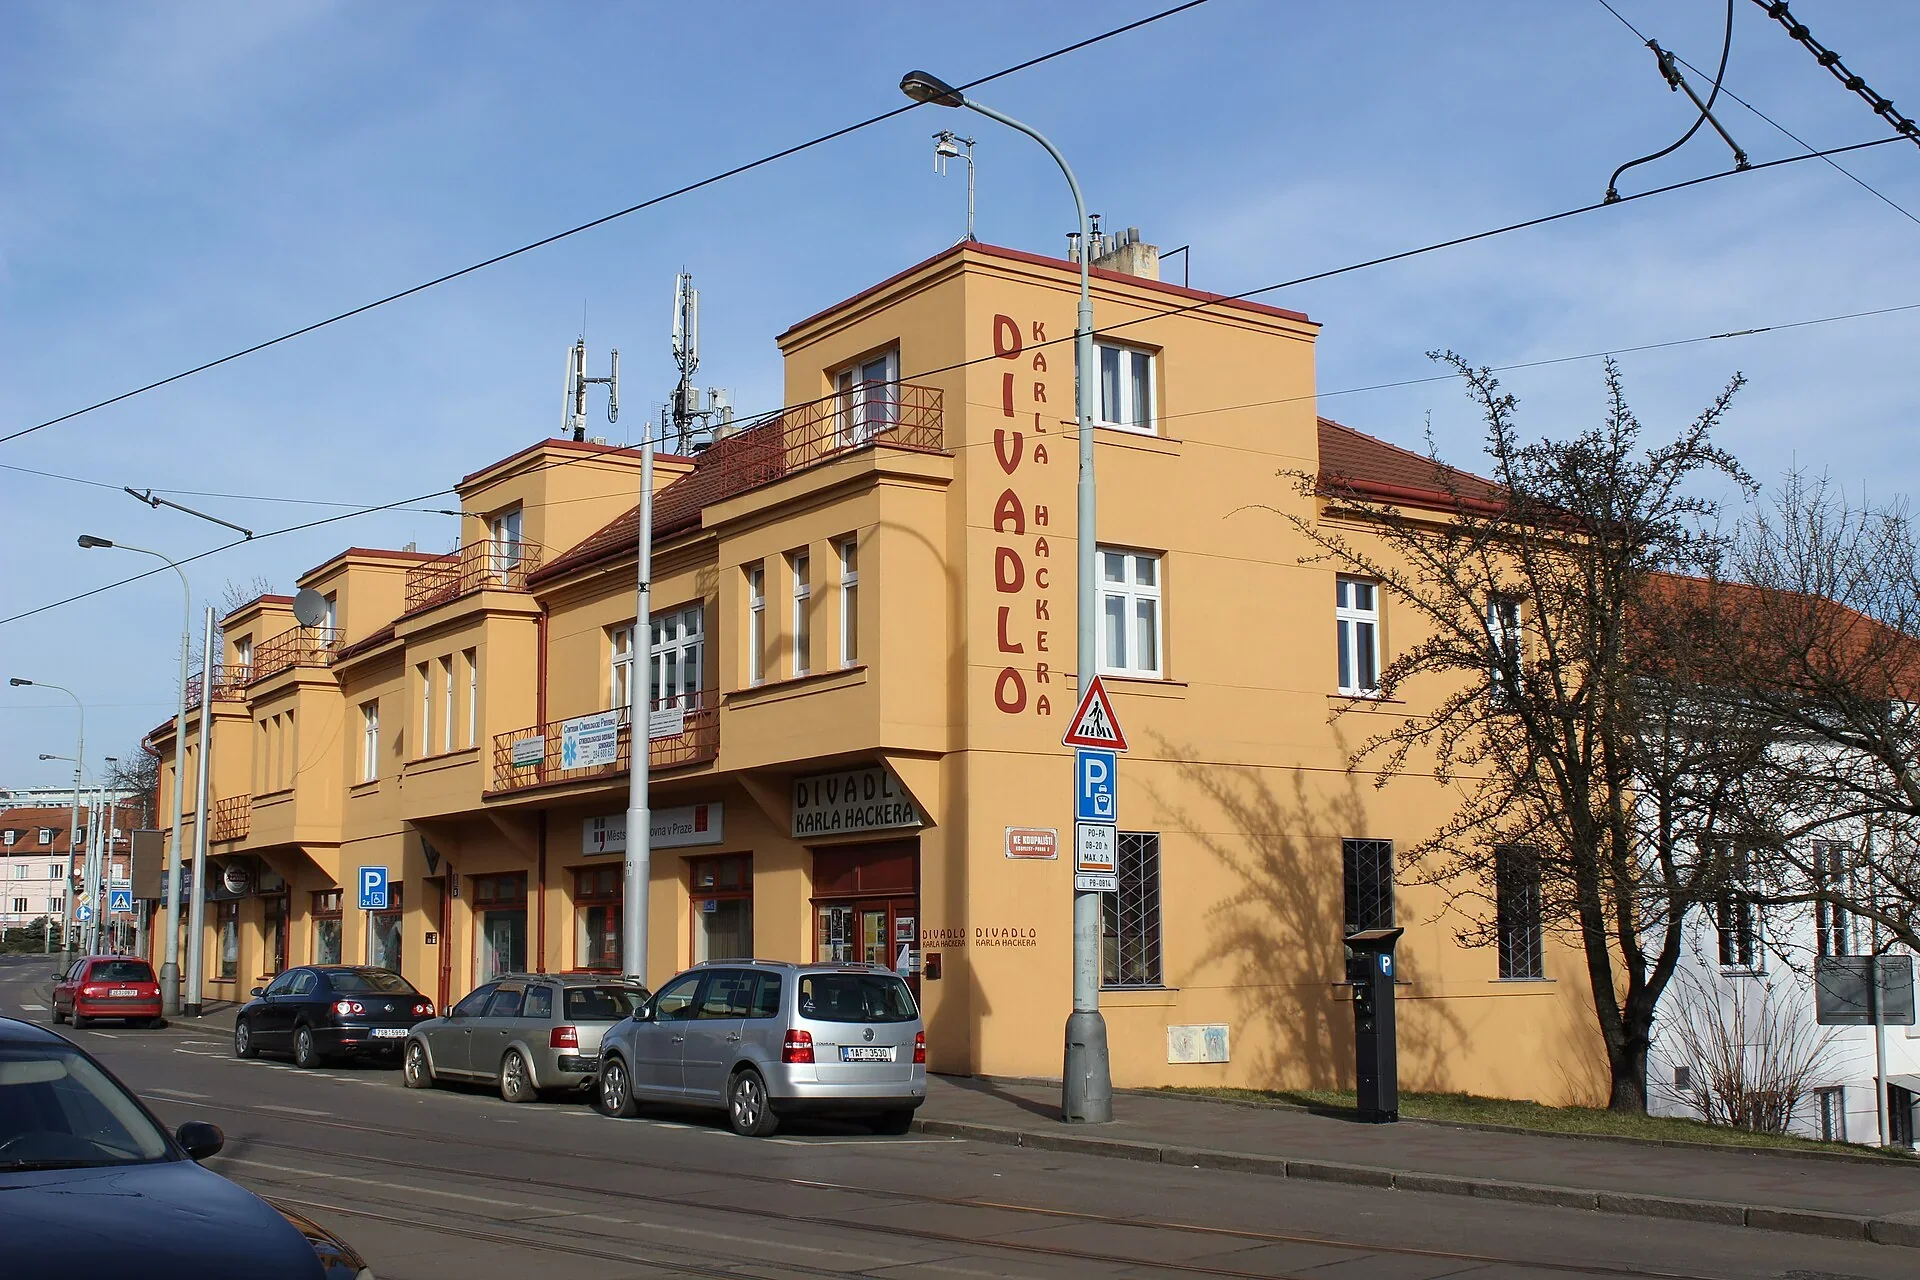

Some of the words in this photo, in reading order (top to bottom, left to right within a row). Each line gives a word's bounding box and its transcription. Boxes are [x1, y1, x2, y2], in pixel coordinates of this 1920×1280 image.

[1032, 321, 1049, 465] KARLA
[993, 314, 1027, 714] DIVADLO
[1034, 504, 1051, 716] HACKERA
[1085, 758, 1108, 798] P
[797, 771, 906, 809] DIVADL
[796, 809, 841, 833] KARLA
[845, 801, 913, 828] HACKERA
[606, 829, 627, 842] Městs
[667, 826, 672, 836] v
[672, 822, 693, 834] Praze
[1013, 835, 1021, 845] KE
[1088, 828, 1106, 838] PO-PÁ
[365, 872, 382, 896] P
[922, 928, 966, 940] DIVADLO
[975, 927, 1037, 938] DIVADLO
[922, 940, 940, 948] KARLA
[940, 939, 966, 948] HACKERA
[975, 939, 1000, 947] KARLA
[1002, 939, 1037, 947] HACKERA
[1382, 956, 1391, 973] P
[850, 1048, 864, 1058] 1AF
[869, 1048, 888, 1058] 3530
